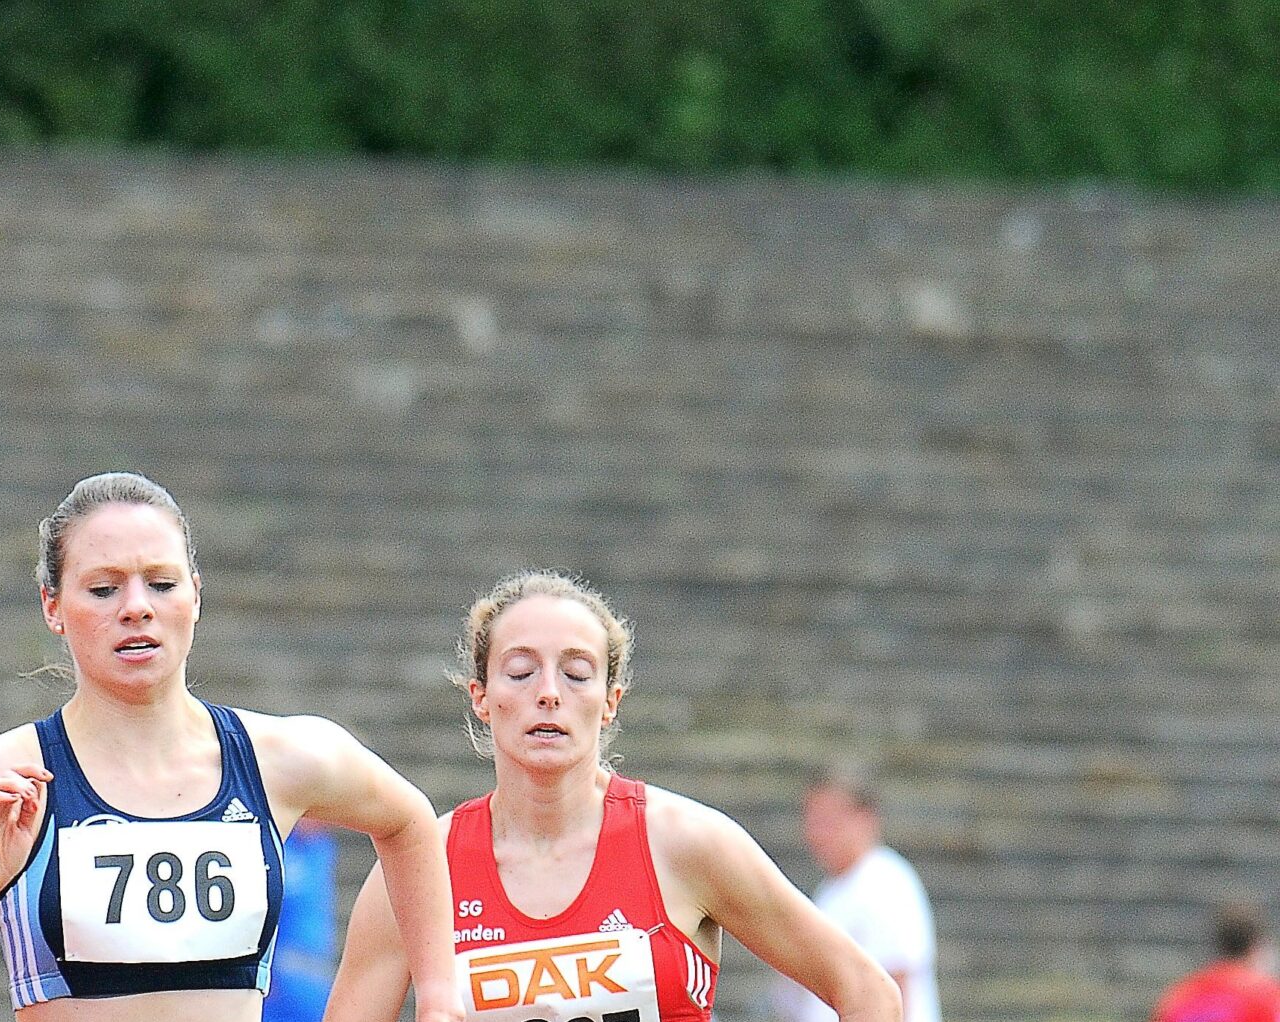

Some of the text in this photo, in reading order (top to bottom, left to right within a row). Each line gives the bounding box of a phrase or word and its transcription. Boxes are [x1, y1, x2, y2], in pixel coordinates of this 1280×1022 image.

[94, 850, 236, 924] 786
[458, 899, 483, 917] SG
[469, 940, 628, 1011] DAK
